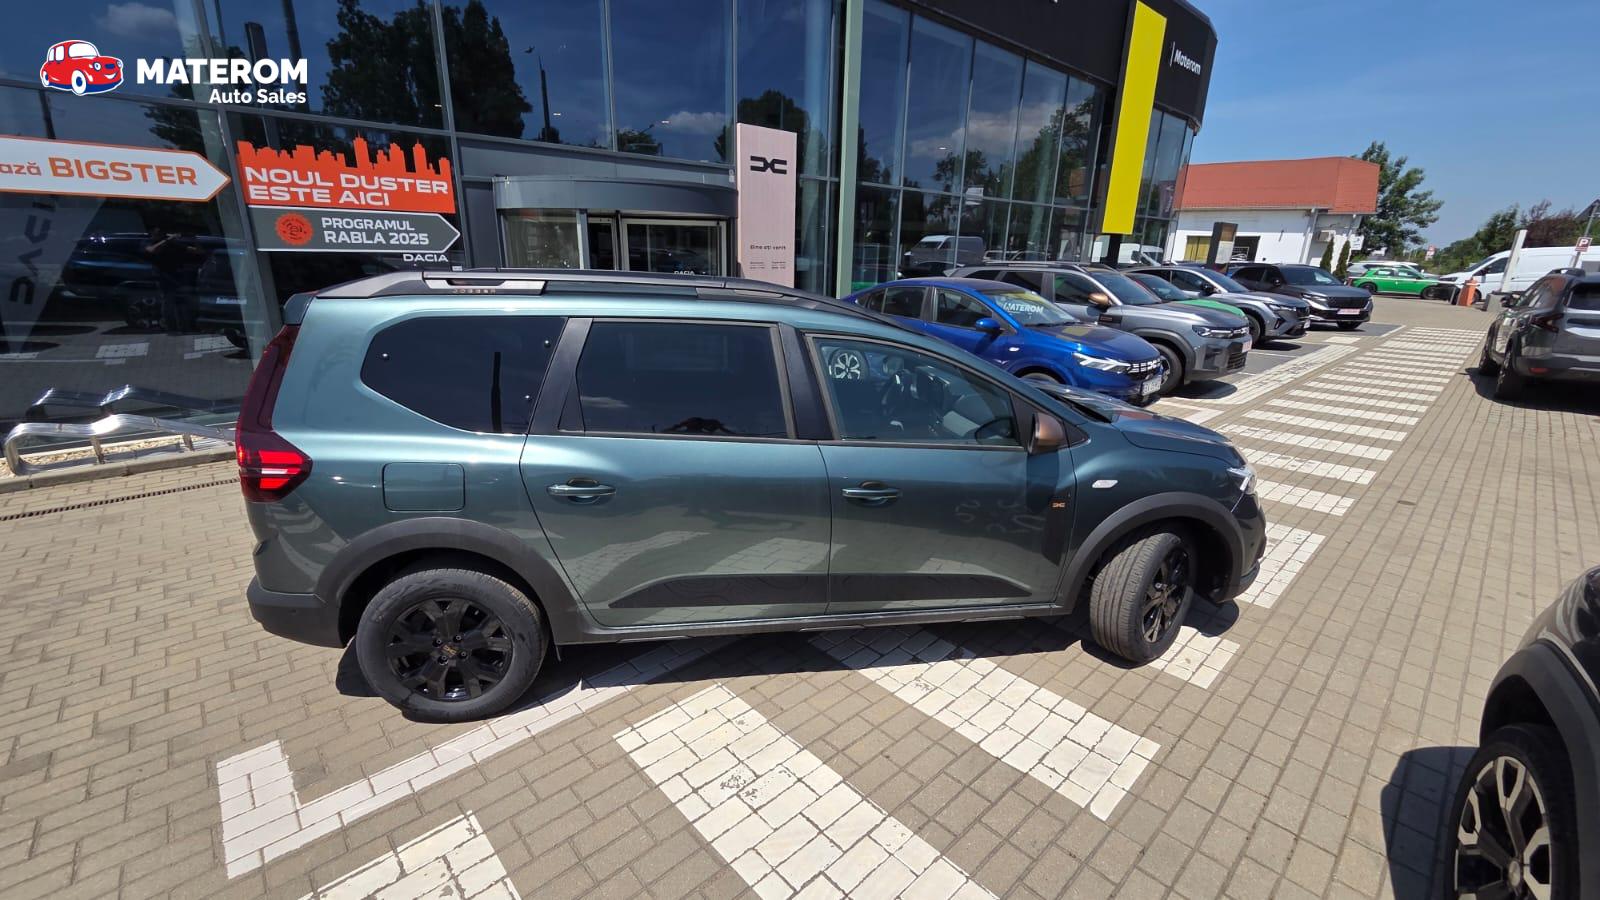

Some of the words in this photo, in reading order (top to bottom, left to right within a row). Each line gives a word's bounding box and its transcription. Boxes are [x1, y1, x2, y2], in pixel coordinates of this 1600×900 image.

[1174, 49, 1201, 75] Materom
[0, 161, 42, 176] ază
[48, 156, 198, 186] BIGSTER
[244, 166, 334, 187] NOUL
[340, 173, 448, 195] DUSTER
[248, 184, 331, 204] ESTE
[338, 190, 390, 207] AICI
[321, 217, 415, 231] PROGRAMUL
[323, 230, 387, 245] RABLA
[389, 232, 430, 246] 2025
[1578, 238, 1589, 247] P
[402, 253, 449, 263] DACIA
[1003, 302, 1044, 313] MATEROM
